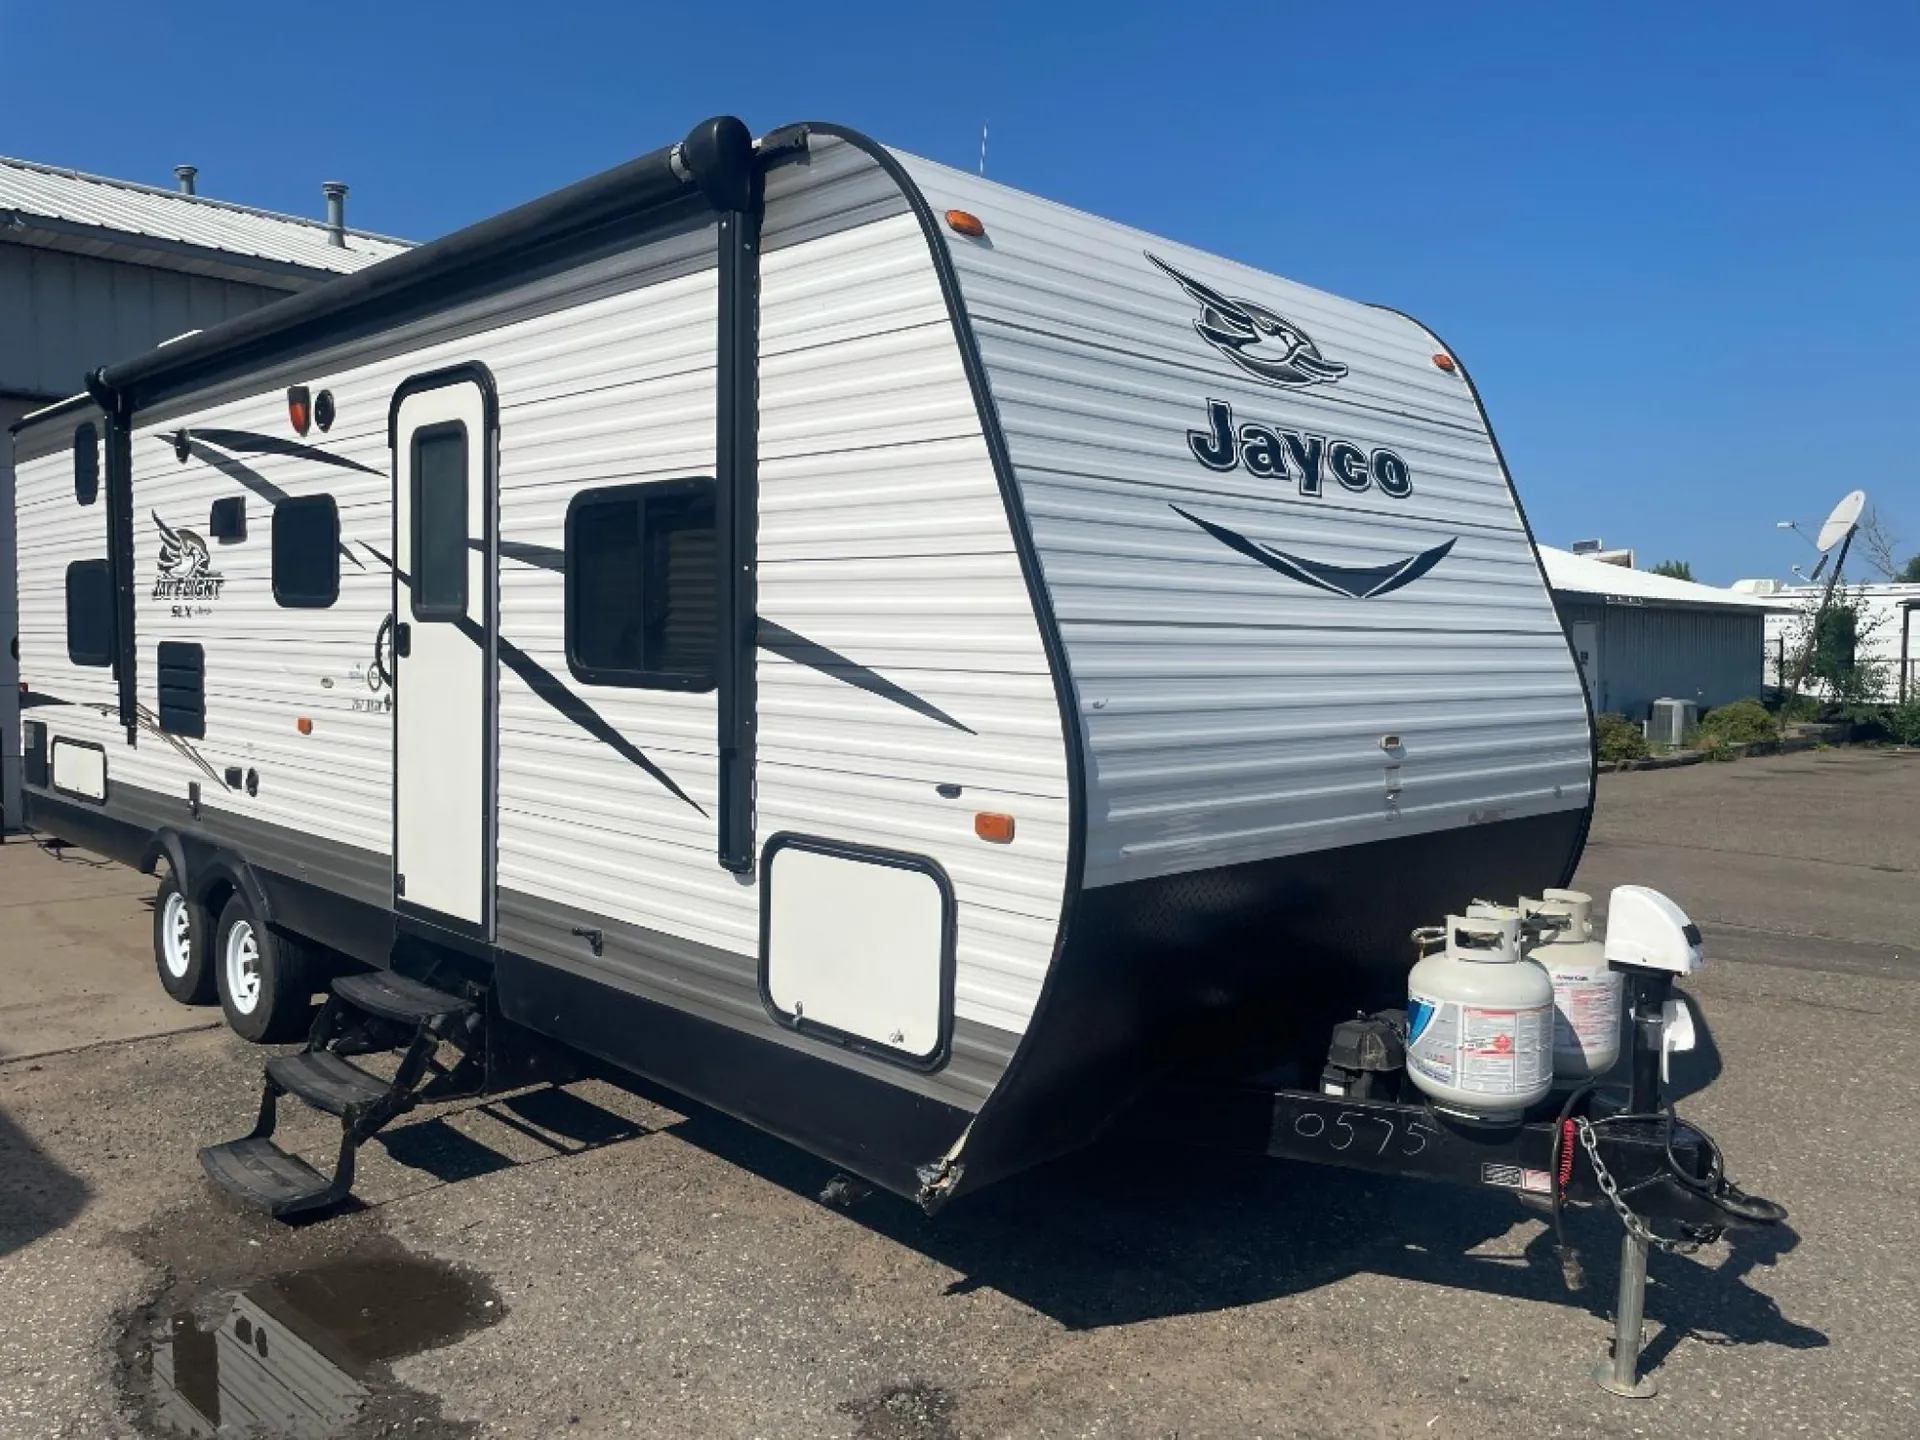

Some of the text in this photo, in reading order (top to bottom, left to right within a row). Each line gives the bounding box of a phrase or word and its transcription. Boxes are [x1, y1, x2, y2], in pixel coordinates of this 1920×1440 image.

[1186, 397, 1413, 498] Jayco
[174, 577, 224, 600] FLIGHT
[1295, 1111, 1441, 1156] 0575
